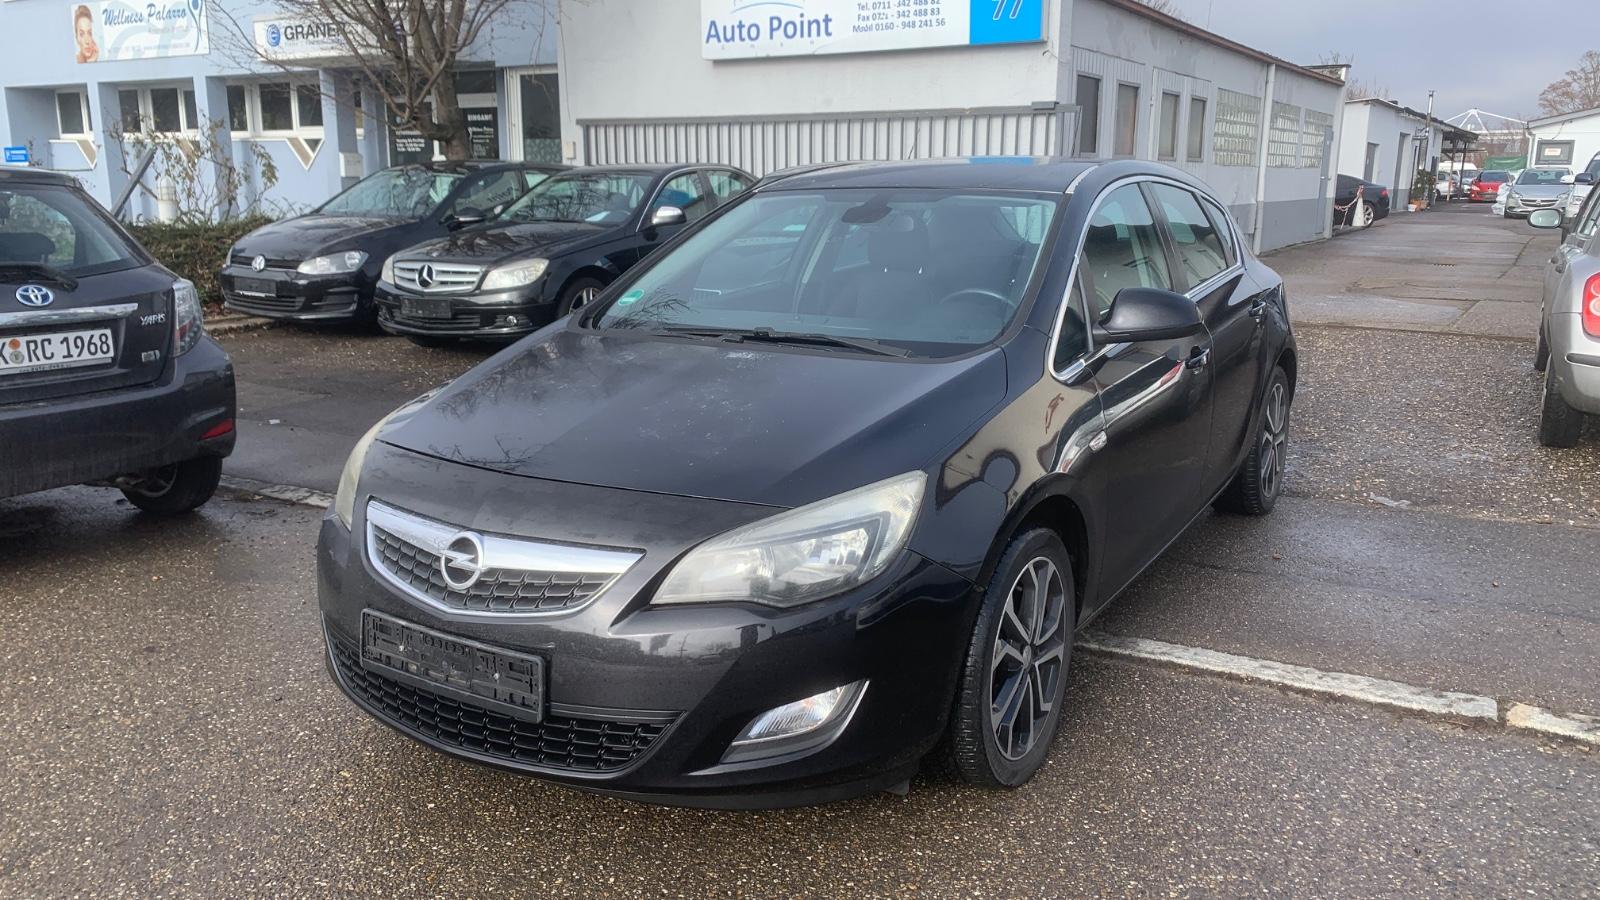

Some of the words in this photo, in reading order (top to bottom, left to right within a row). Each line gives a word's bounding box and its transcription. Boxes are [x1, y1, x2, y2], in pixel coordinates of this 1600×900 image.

[857, 2, 870, 11] Tel.
[872, 1, 891, 10] 0711
[896, 0, 911, 8] 342
[102, 8, 144, 26] Wellness
[147, 3, 187, 23] Palazzo
[857, 13, 870, 22] Fax
[896, 10, 911, 18] 342
[913, 8, 928, 17] 488
[930, 8, 940, 16] 83
[706, 19, 761, 44] Auto
[769, 12, 833, 40] Point
[852, 23, 874, 33] Mobil
[875, 22, 895, 31] 0160
[901, 20, 916, 29] 948
[918, 19, 933, 28] 241
[935, 18, 946, 27] 56
[140, 313, 166, 326] YARIS
[26, 337, 55, 363] RC
[60, 332, 111, 359] 1968
